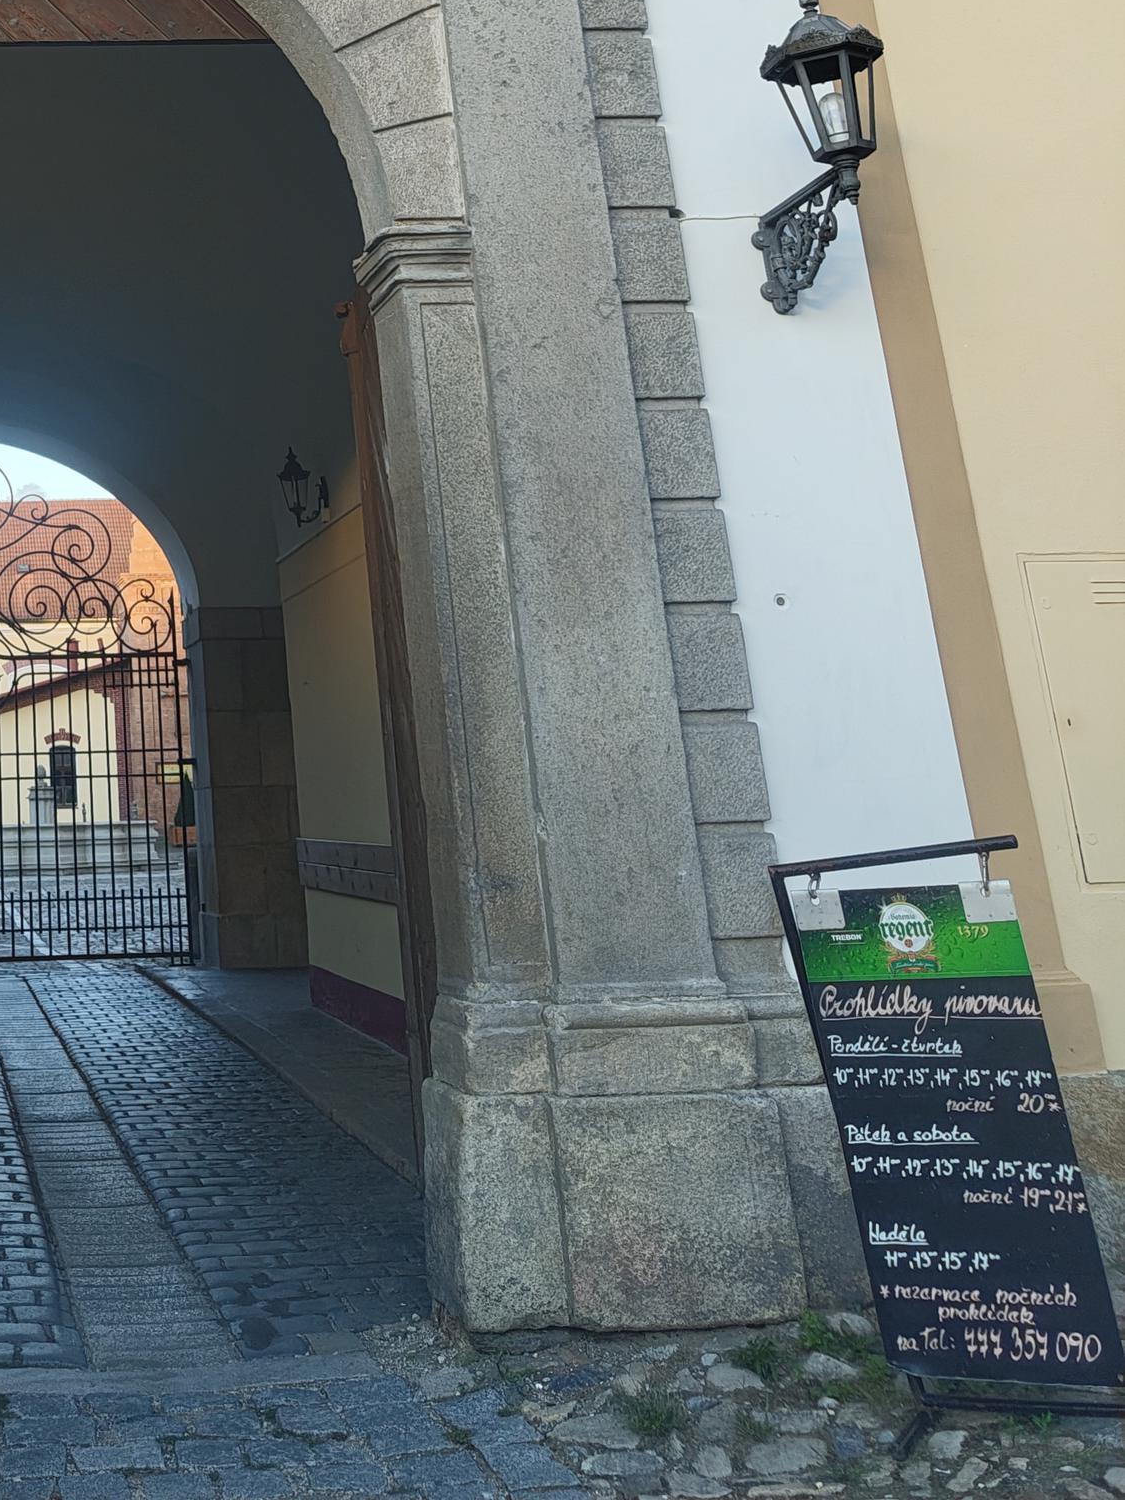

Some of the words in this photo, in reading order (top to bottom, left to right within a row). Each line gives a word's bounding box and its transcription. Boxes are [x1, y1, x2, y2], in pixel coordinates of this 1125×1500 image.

[880, 919, 934, 941] regent
[819, 984, 933, 1035] Prohlídky
[945, 985, 1043, 1026] pivovaru
[827, 1034, 888, 1055] Pondělí
[844, 1123, 893, 1142] Pátek
[897, 1131, 909, 1142] a
[913, 1124, 975, 1142] sobota
[894, 1284, 981, 1302] rezervace
[897, 1335, 917, 1351] na
[964, 1326, 1003, 1359] 777
[1011, 1327, 1048, 1361] 357
[1056, 1331, 1102, 1362] 090
